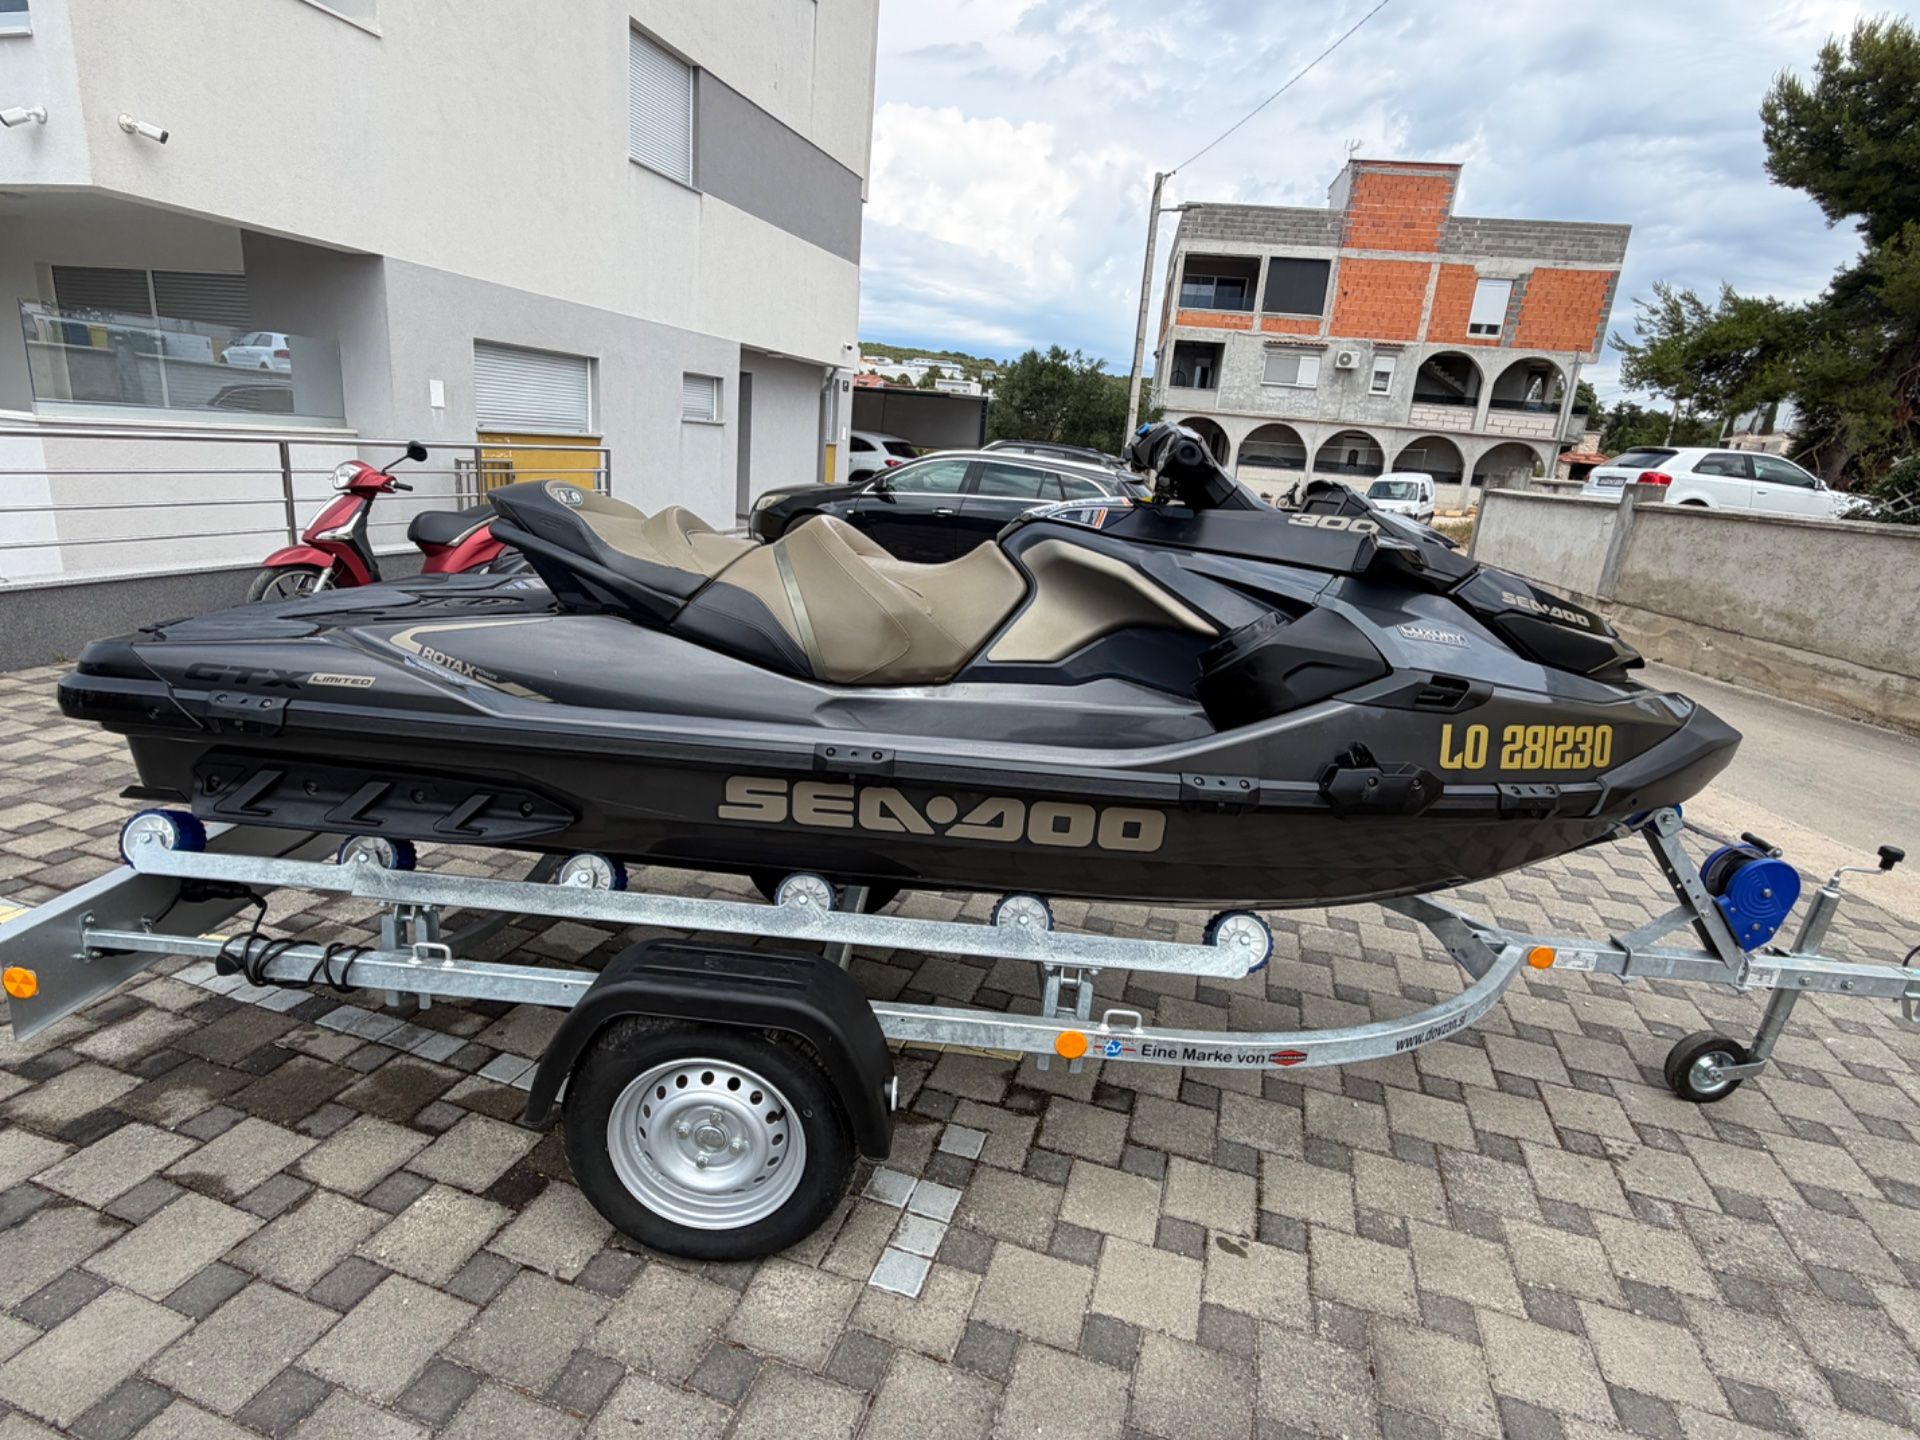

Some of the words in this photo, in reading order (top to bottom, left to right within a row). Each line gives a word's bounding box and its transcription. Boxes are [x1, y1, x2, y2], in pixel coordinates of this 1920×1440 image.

[1288, 513, 1380, 534] 300
[422, 646, 476, 677] ROTAX
[184, 662, 312, 689] GTX
[311, 675, 373, 687] LIMITED
[1439, 723, 1489, 769] LO
[1500, 724, 1613, 769] 281230
[1141, 1044, 1178, 1060] Eine
[1182, 1047, 1233, 1063] Marke
[1237, 1053, 1266, 1064] von
